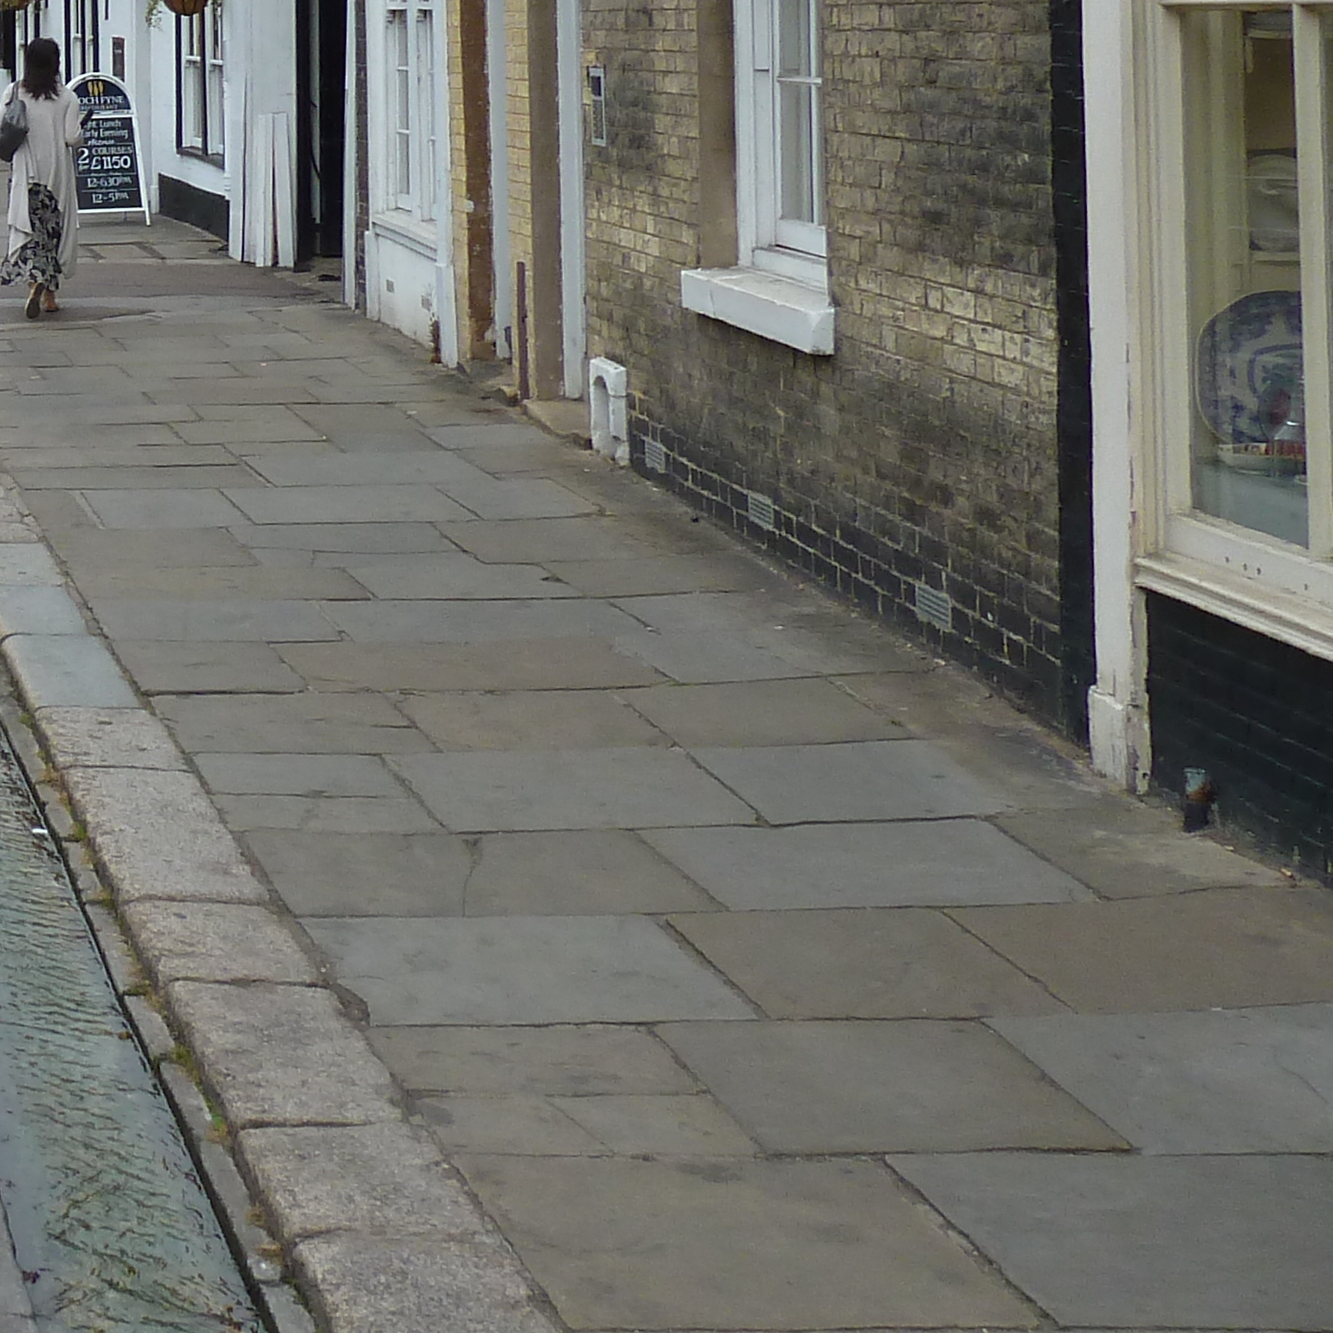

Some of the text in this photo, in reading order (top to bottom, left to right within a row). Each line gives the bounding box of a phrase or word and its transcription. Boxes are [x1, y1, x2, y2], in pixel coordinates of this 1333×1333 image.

[78, 95, 124, 105] OCH FYNE
[77, 147, 90, 164] 2
[91, 146, 133, 155] COURSES
